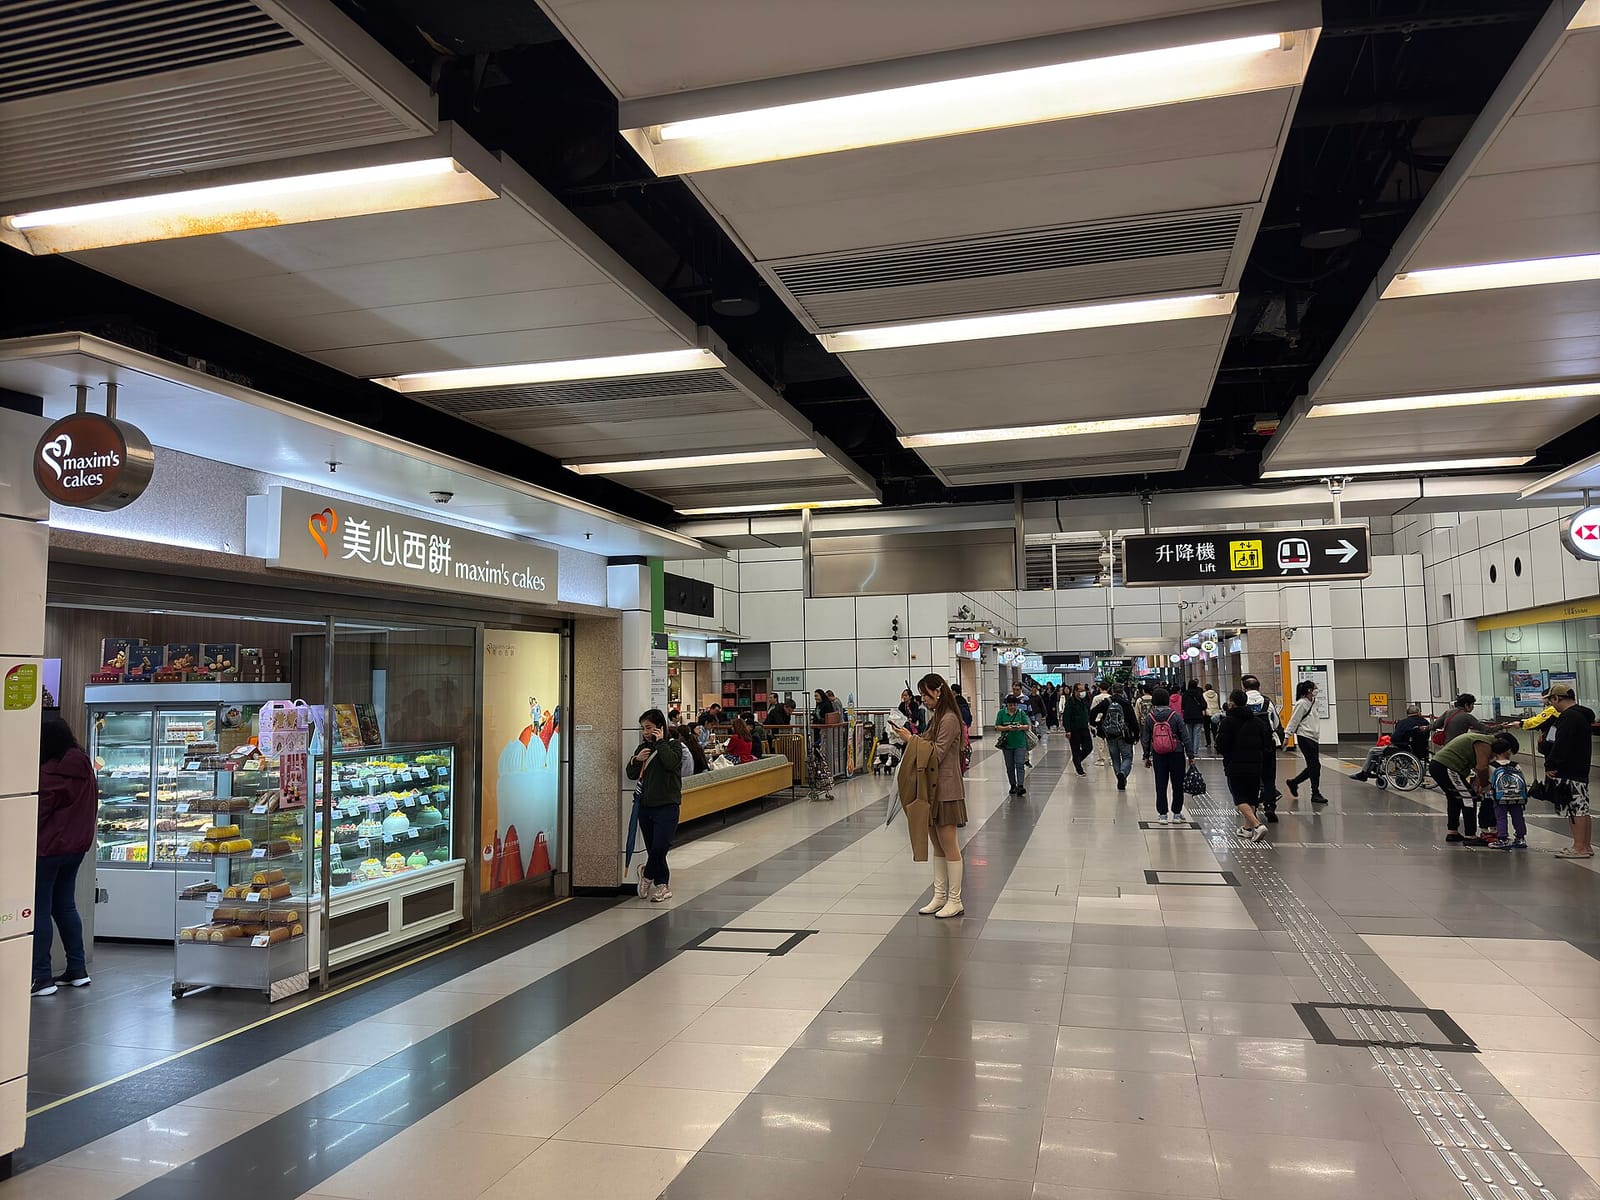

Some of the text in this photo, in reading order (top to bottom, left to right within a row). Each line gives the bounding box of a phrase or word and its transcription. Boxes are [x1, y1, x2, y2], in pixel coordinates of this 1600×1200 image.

[63, 450, 120, 469] maxim's
[63, 469, 104, 488] cakes
[341, 516, 452, 577] 美心西餅
[1155, 542, 1216, 562] 升降機
[455, 560, 546, 592] maxim's cakes
[1199, 563, 1216, 573] Lift
